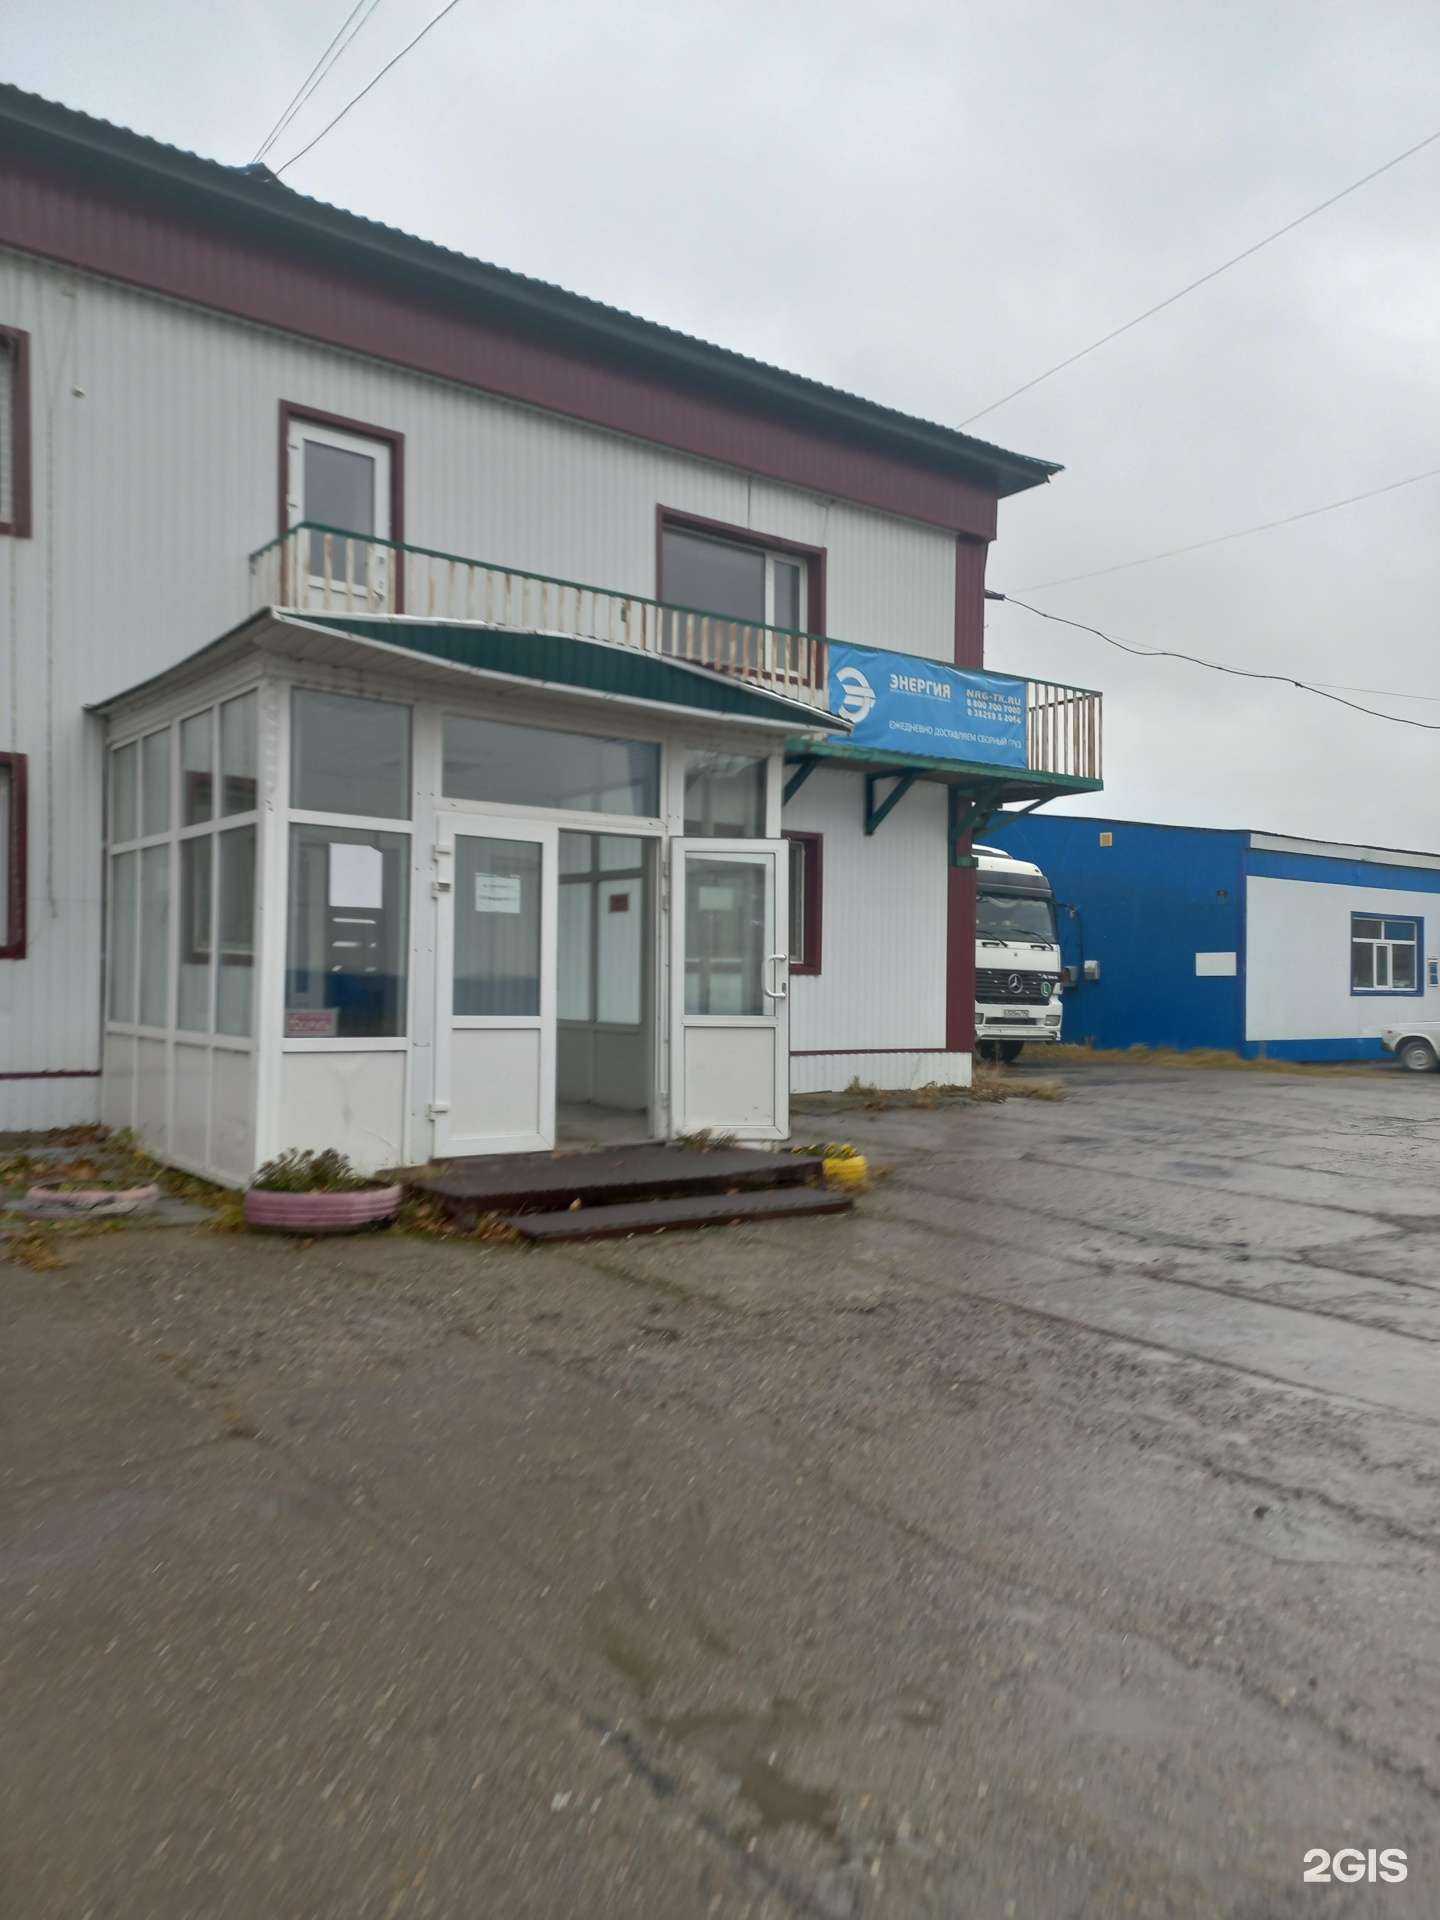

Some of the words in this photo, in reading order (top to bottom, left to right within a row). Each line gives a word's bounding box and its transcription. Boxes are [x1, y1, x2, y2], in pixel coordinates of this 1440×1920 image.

[889, 673, 951, 699] ЭНЕРГИЯ
[966, 689, 1021, 706] NRG-TK.RU
[973, 699, 987, 710] 800
[989, 702, 1002, 712] 700
[888, 719, 933, 735] ЕЖЕДНЕВНО
[933, 727, 976, 742] ДОСТАВЛЯЕМ
